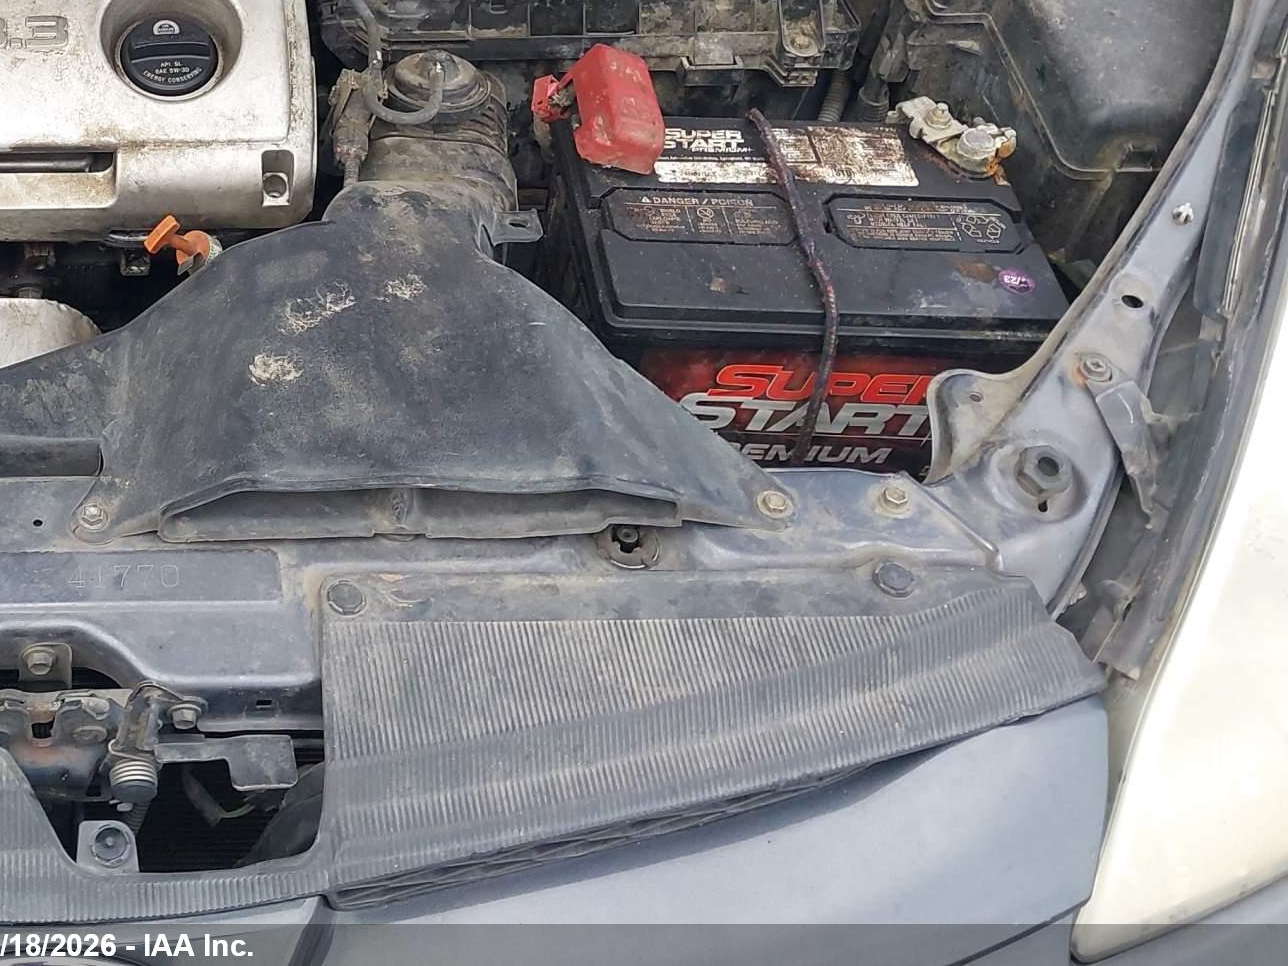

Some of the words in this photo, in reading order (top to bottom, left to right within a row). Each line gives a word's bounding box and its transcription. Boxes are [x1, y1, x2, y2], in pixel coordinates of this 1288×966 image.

[664, 128, 743, 141] SUPER
[663, 138, 745, 150] START
[652, 196, 699, 205] DANGER
[712, 197, 754, 207] POISON
[679, 392, 930, 436] START
